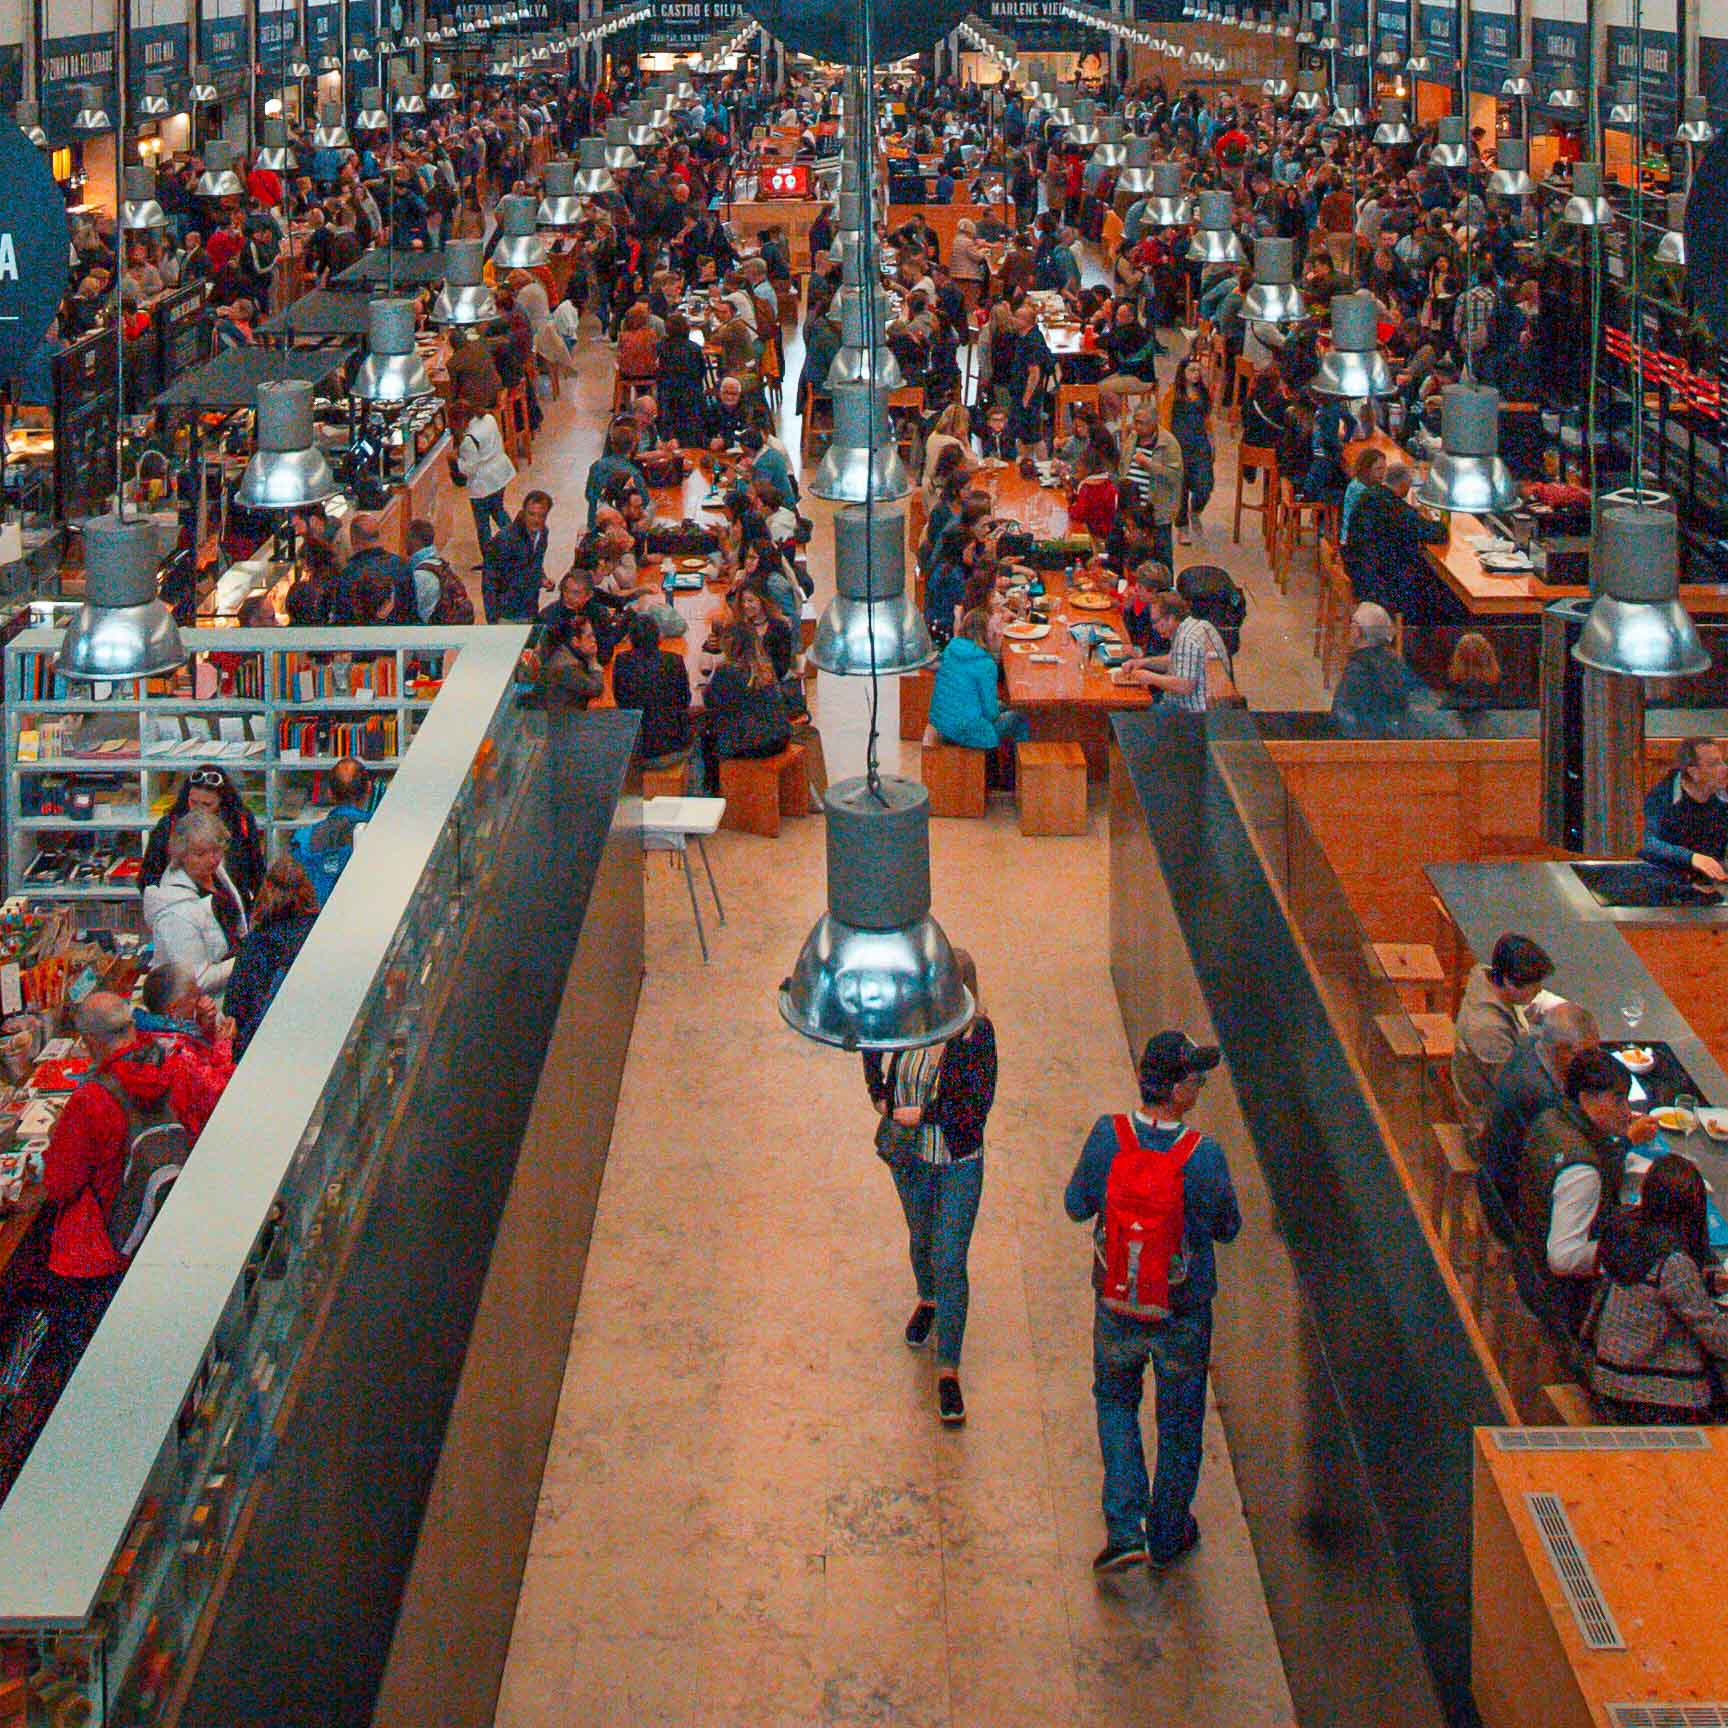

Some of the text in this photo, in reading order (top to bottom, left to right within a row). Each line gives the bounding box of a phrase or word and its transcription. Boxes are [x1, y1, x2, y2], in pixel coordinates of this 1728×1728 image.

[661, 4, 701, 17] CASTRO
[714, 4, 744, 17] SILVA
[991, 2, 1039, 15] MARLENE
